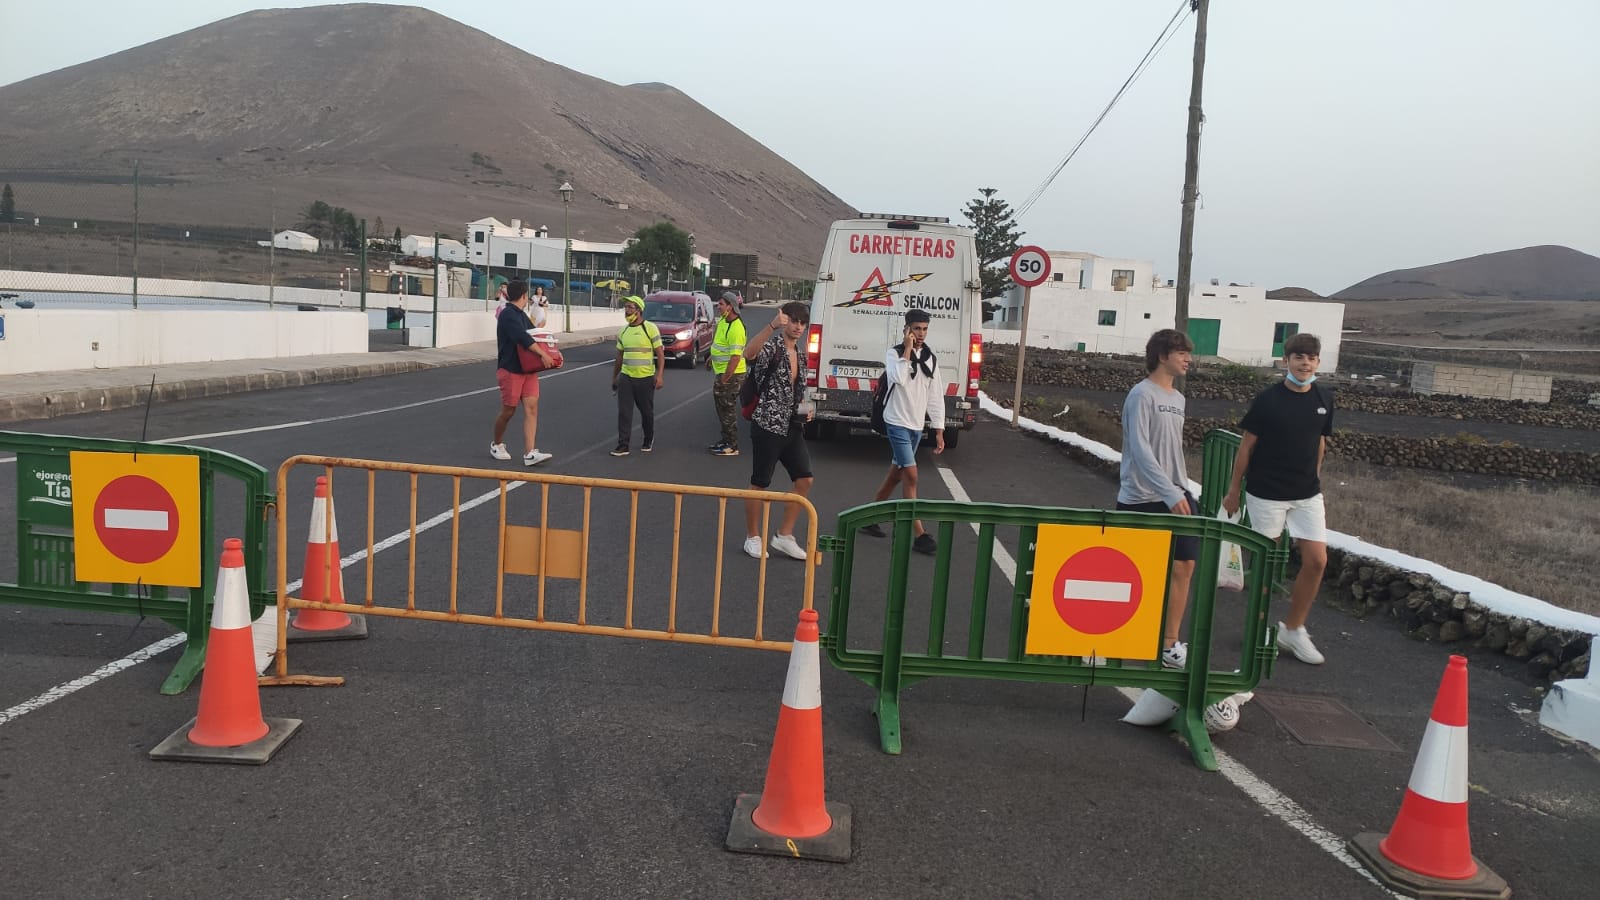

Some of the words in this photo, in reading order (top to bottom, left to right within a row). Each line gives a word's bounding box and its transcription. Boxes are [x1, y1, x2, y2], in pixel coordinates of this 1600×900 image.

[849, 234, 956, 259] CARRETERAS
[1020, 260, 1041, 273] 50
[903, 293, 960, 311] SEÑALCON
[838, 367, 859, 376] 7037
[44, 481, 71, 498] Tía
